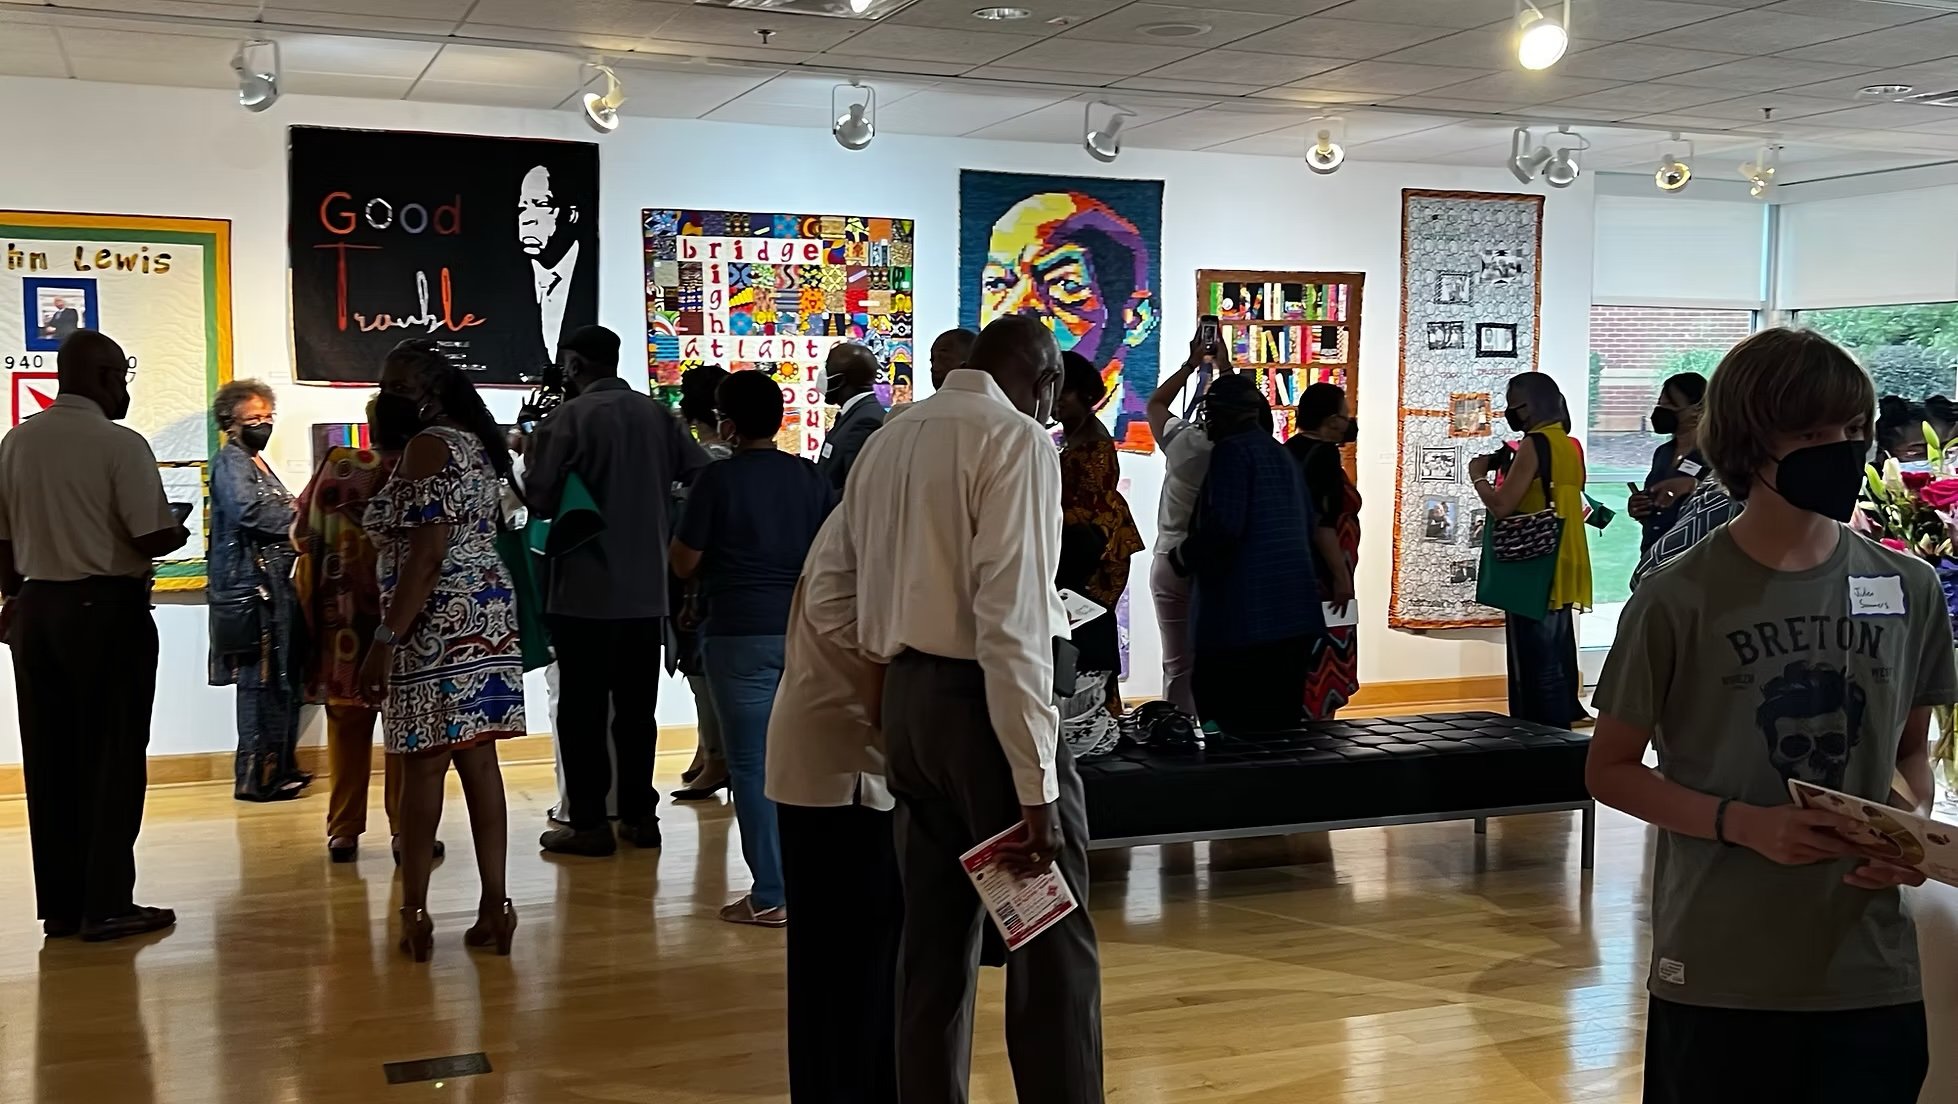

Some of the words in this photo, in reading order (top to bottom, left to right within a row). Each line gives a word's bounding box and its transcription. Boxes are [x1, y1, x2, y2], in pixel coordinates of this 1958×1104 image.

[319, 190, 463, 235] Good
[0, 242, 48, 272] hn
[74, 244, 173, 275] Lewis
[683, 238, 820, 261] bridge
[313, 240, 488, 334] Trouble
[707, 240, 726, 369] right
[4, 353, 43, 370] 940
[684, 338, 845, 359] atlant
[805, 340, 821, 462] troub
[1726, 614, 1885, 667] BRETON
